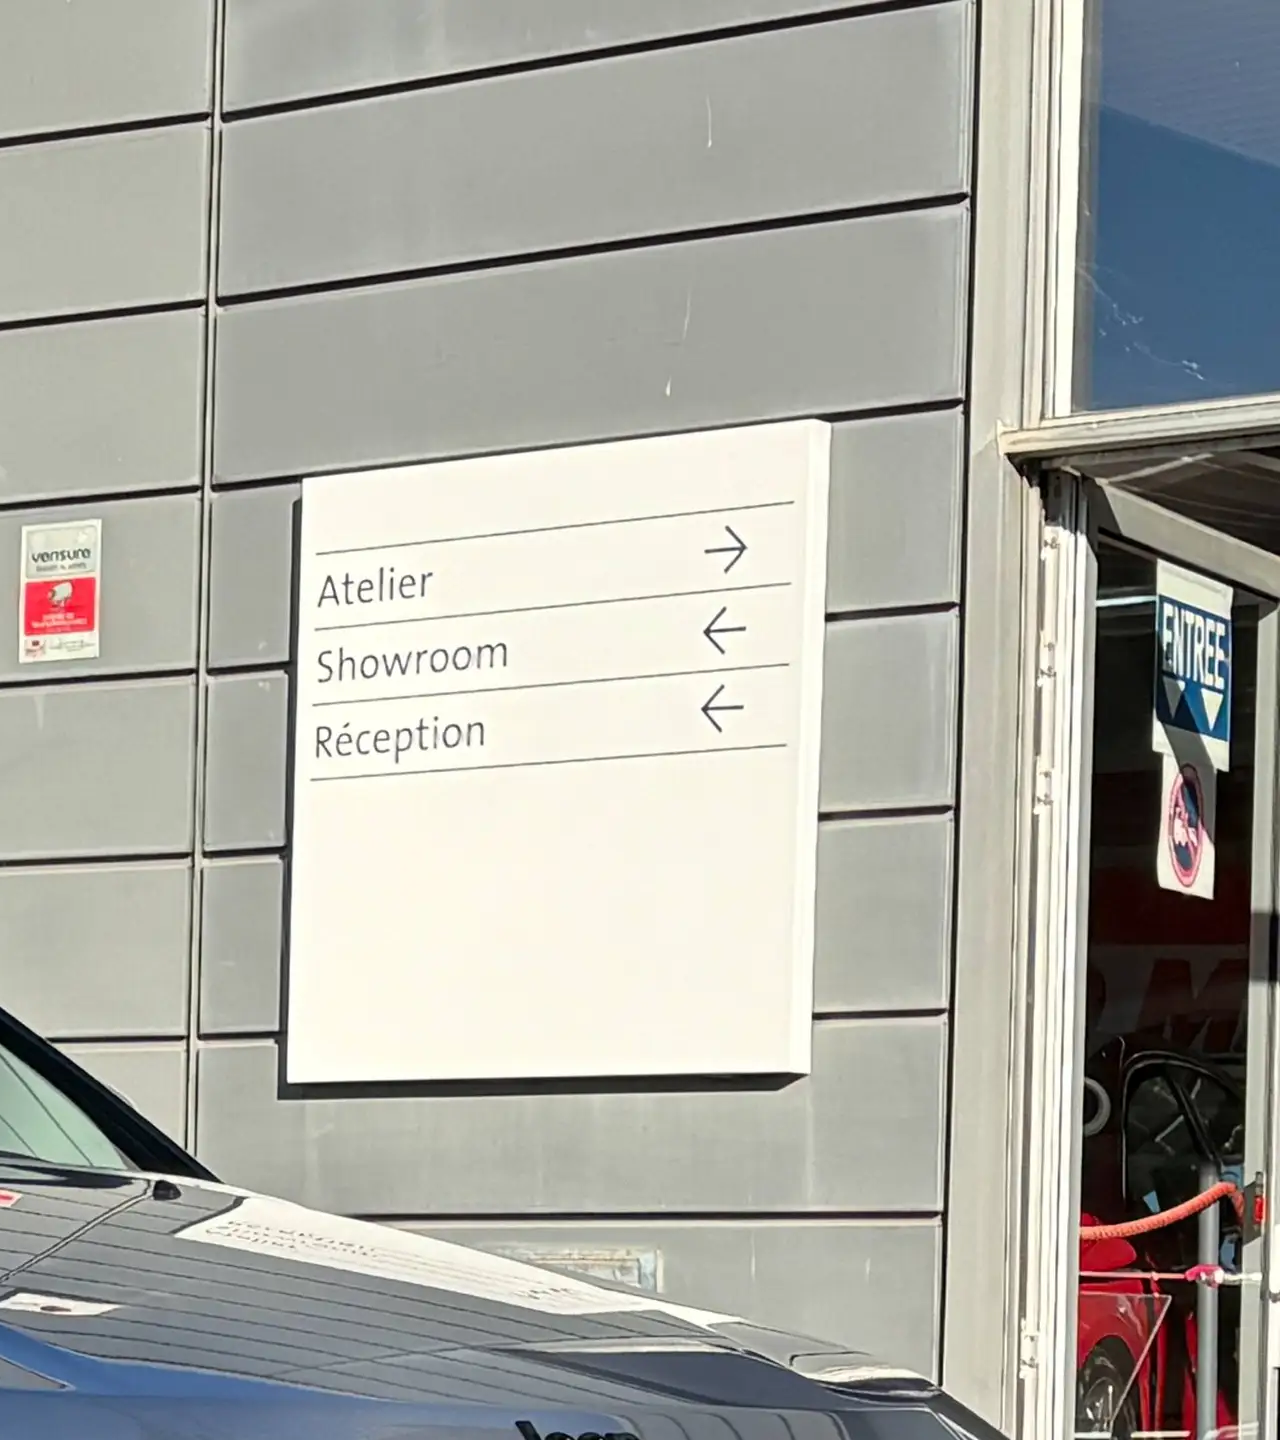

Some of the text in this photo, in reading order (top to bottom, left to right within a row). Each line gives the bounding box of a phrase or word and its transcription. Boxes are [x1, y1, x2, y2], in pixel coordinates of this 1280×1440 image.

[317, 567, 434, 608] Atelier
[317, 641, 509, 684] Showroom
[1162, 602, 1225, 690] ENTREE
[315, 715, 486, 764] Réception
